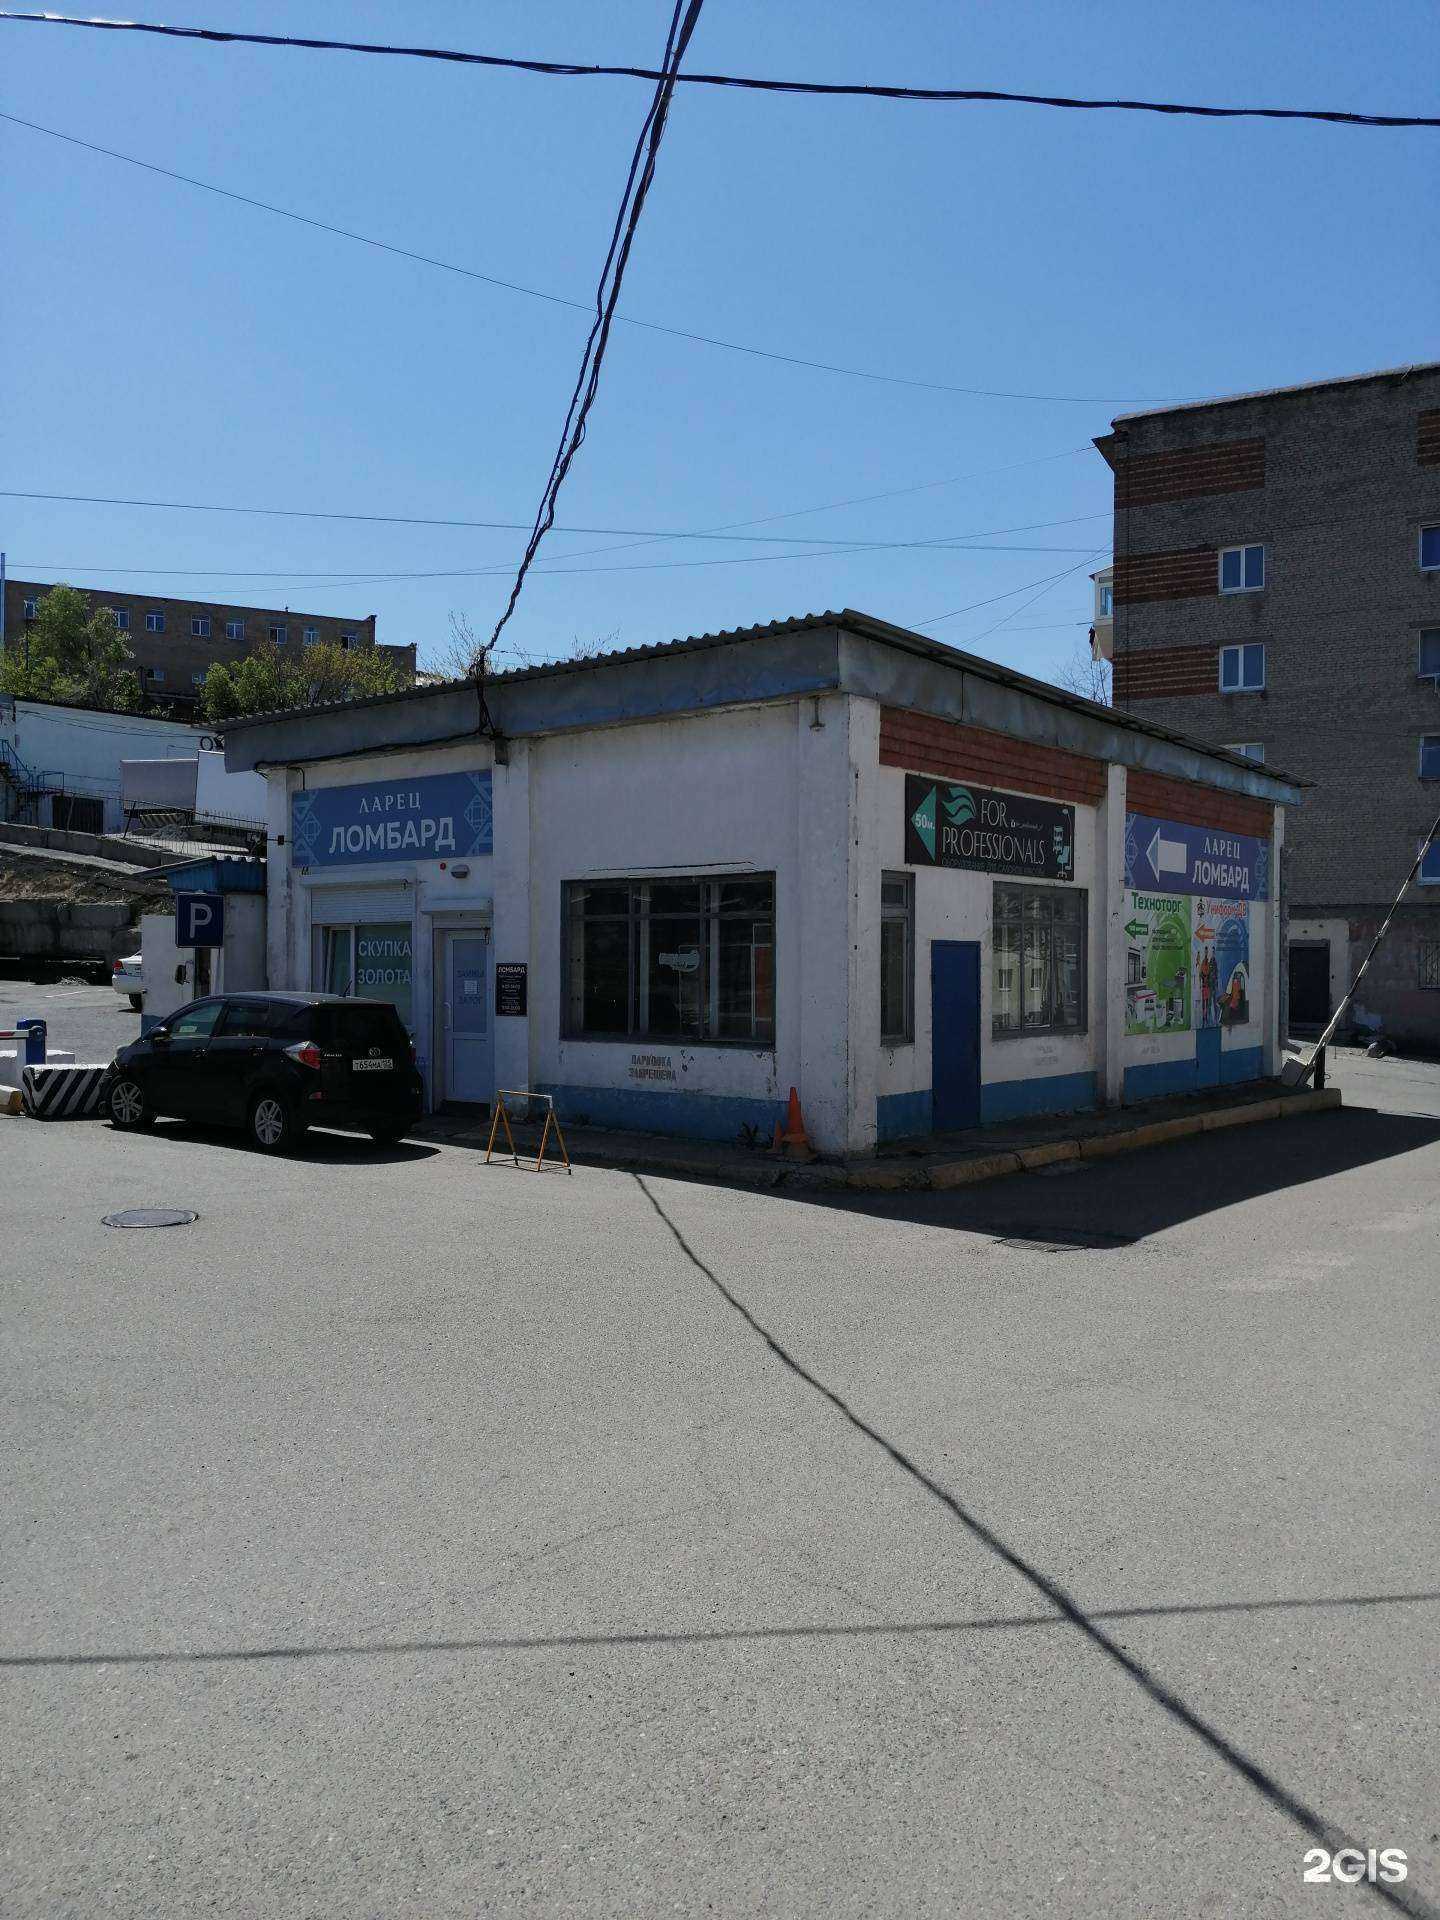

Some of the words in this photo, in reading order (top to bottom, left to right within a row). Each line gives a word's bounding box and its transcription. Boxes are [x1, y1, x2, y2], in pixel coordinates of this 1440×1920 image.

[359, 792, 422, 814] ЛАРЕЦ
[981, 799, 1009, 828] FOR
[329, 817, 456, 854] ЛОМБАРД
[942, 827, 1046, 866] PROFESSIONALS
[1204, 837, 1241, 859] ЛАРЕЦ
[1192, 860, 1250, 894] ЛОМБАРД
[1131, 891, 1183, 914] Техноторг
[190, 902, 212, 939] P
[358, 940, 412, 958] СКУПКА
[357, 968, 412, 985] ЗОЛОТА
